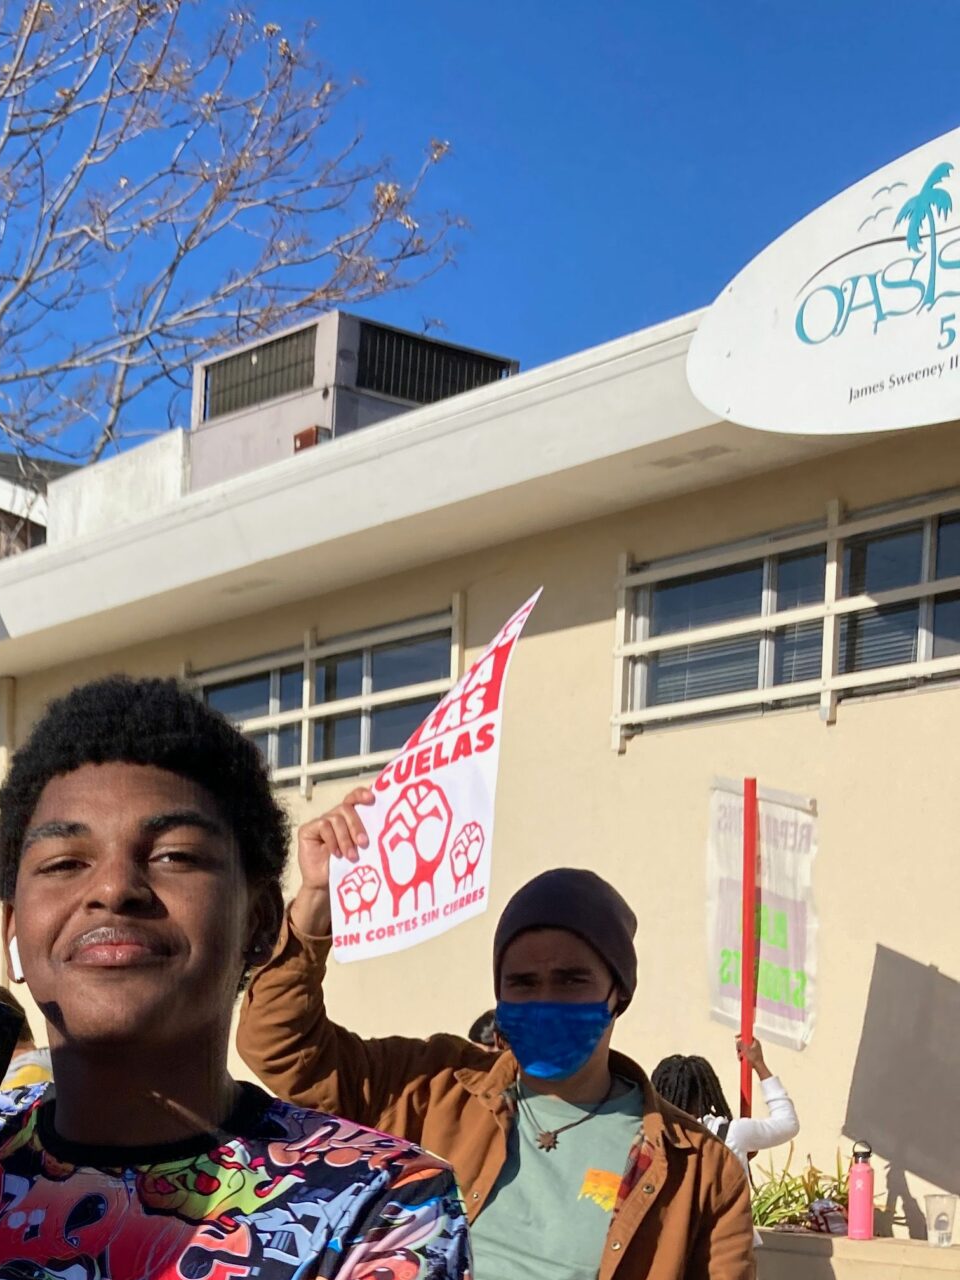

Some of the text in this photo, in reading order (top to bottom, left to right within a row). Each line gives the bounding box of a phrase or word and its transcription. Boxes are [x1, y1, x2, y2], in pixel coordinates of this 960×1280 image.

[848, 379, 885, 405] James
[888, 361, 945, 390] Sweeney
[417, 687, 486, 745] LAS
[374, 721, 496, 793] CUELAS
[334, 886, 486, 948] SIN CORTES SIN CIERRES
